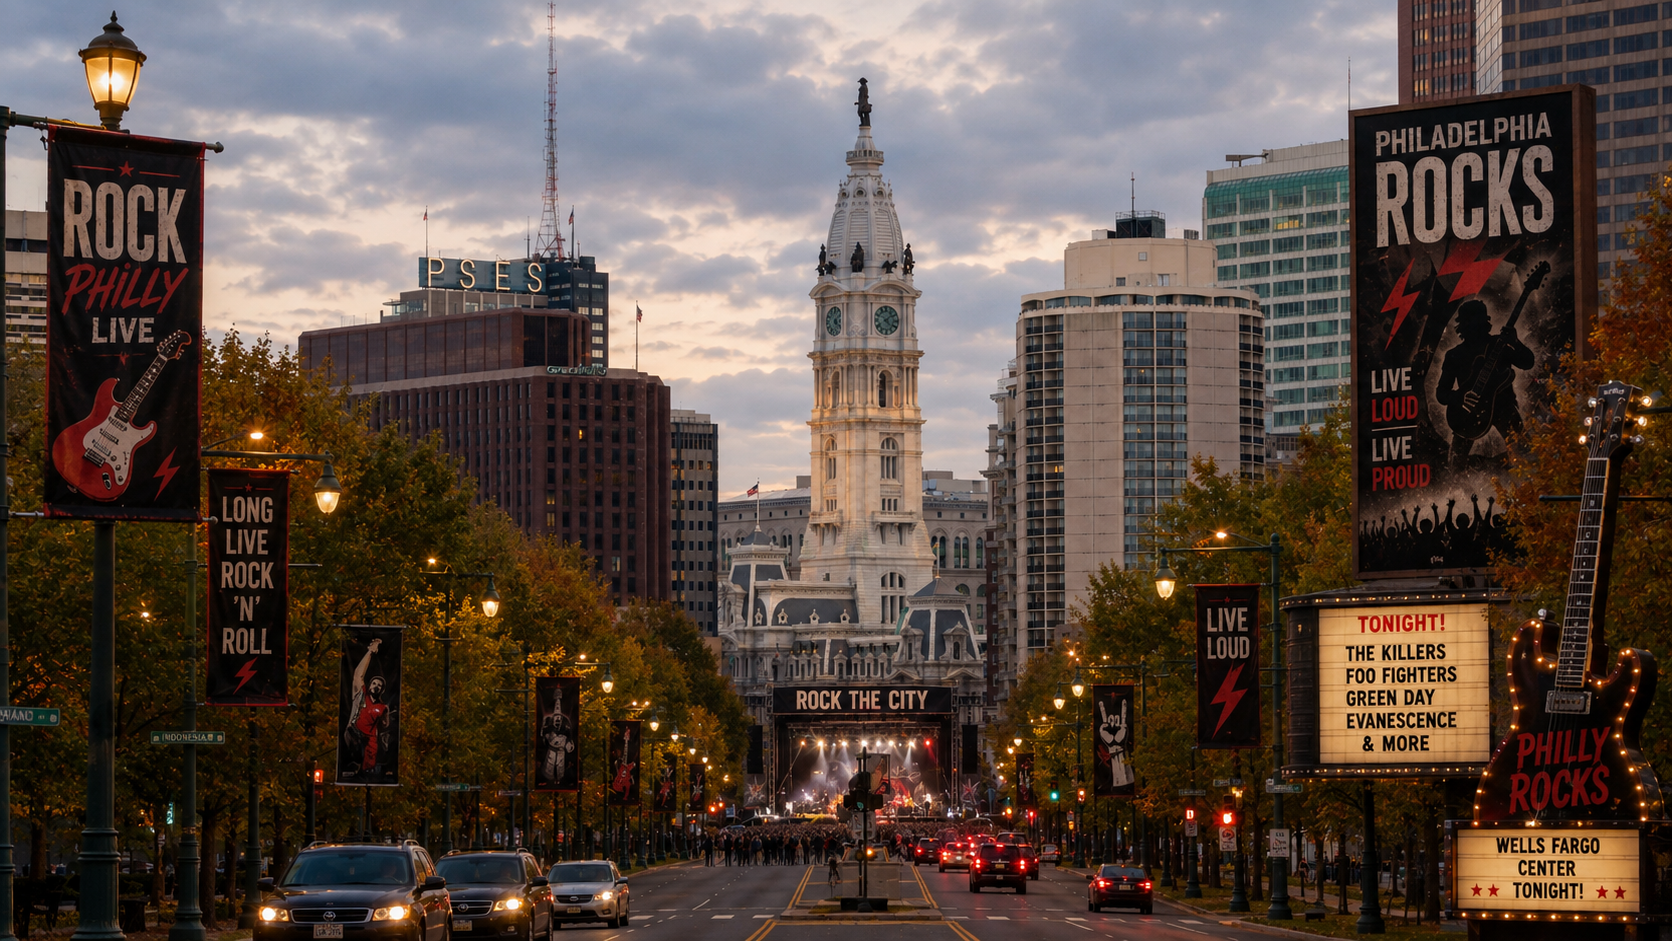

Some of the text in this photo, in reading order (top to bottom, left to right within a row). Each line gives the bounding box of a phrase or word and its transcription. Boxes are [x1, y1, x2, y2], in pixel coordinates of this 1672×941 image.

[1376, 112, 1552, 156] PHILADELPHIA
[1376, 144, 1554, 248] ROCKS
[63, 179, 187, 264] ROCK
[427, 257, 542, 292] PSES
[91, 317, 155, 344] LIVE
[1371, 367, 1412, 394] LIVE
[1371, 395, 1419, 423] LOUD
[1372, 435, 1412, 462] LIVE
[1372, 463, 1431, 492] PROUD
[222, 496, 273, 523] LONG
[226, 529, 268, 555] LIVE
[221, 561, 274, 589] ROCK
[1206, 607, 1249, 633] LIVE
[1357, 613, 1446, 634] TONIGHT!
[222, 627, 272, 654] ROLL
[1206, 636, 1250, 660] LOUD
[1345, 643, 1446, 662] THE KILLERS
[1346, 665, 1457, 684] FOO FIGHTERS
[796, 690, 929, 710] ROCK THE CITY
[1346, 688, 1436, 707] GREEN DAY
[1346, 711, 1457, 730] EVANESCENCE
[1362, 734, 1430, 752] & MORE
[1516, 726, 1611, 771] PHILLY
[1508, 764, 1611, 815] ROCKS
[1495, 836, 1600, 854] WELLS FARGO
[1518, 859, 1576, 877] CENTER
[1512, 881, 1584, 899] TONIGHT!
